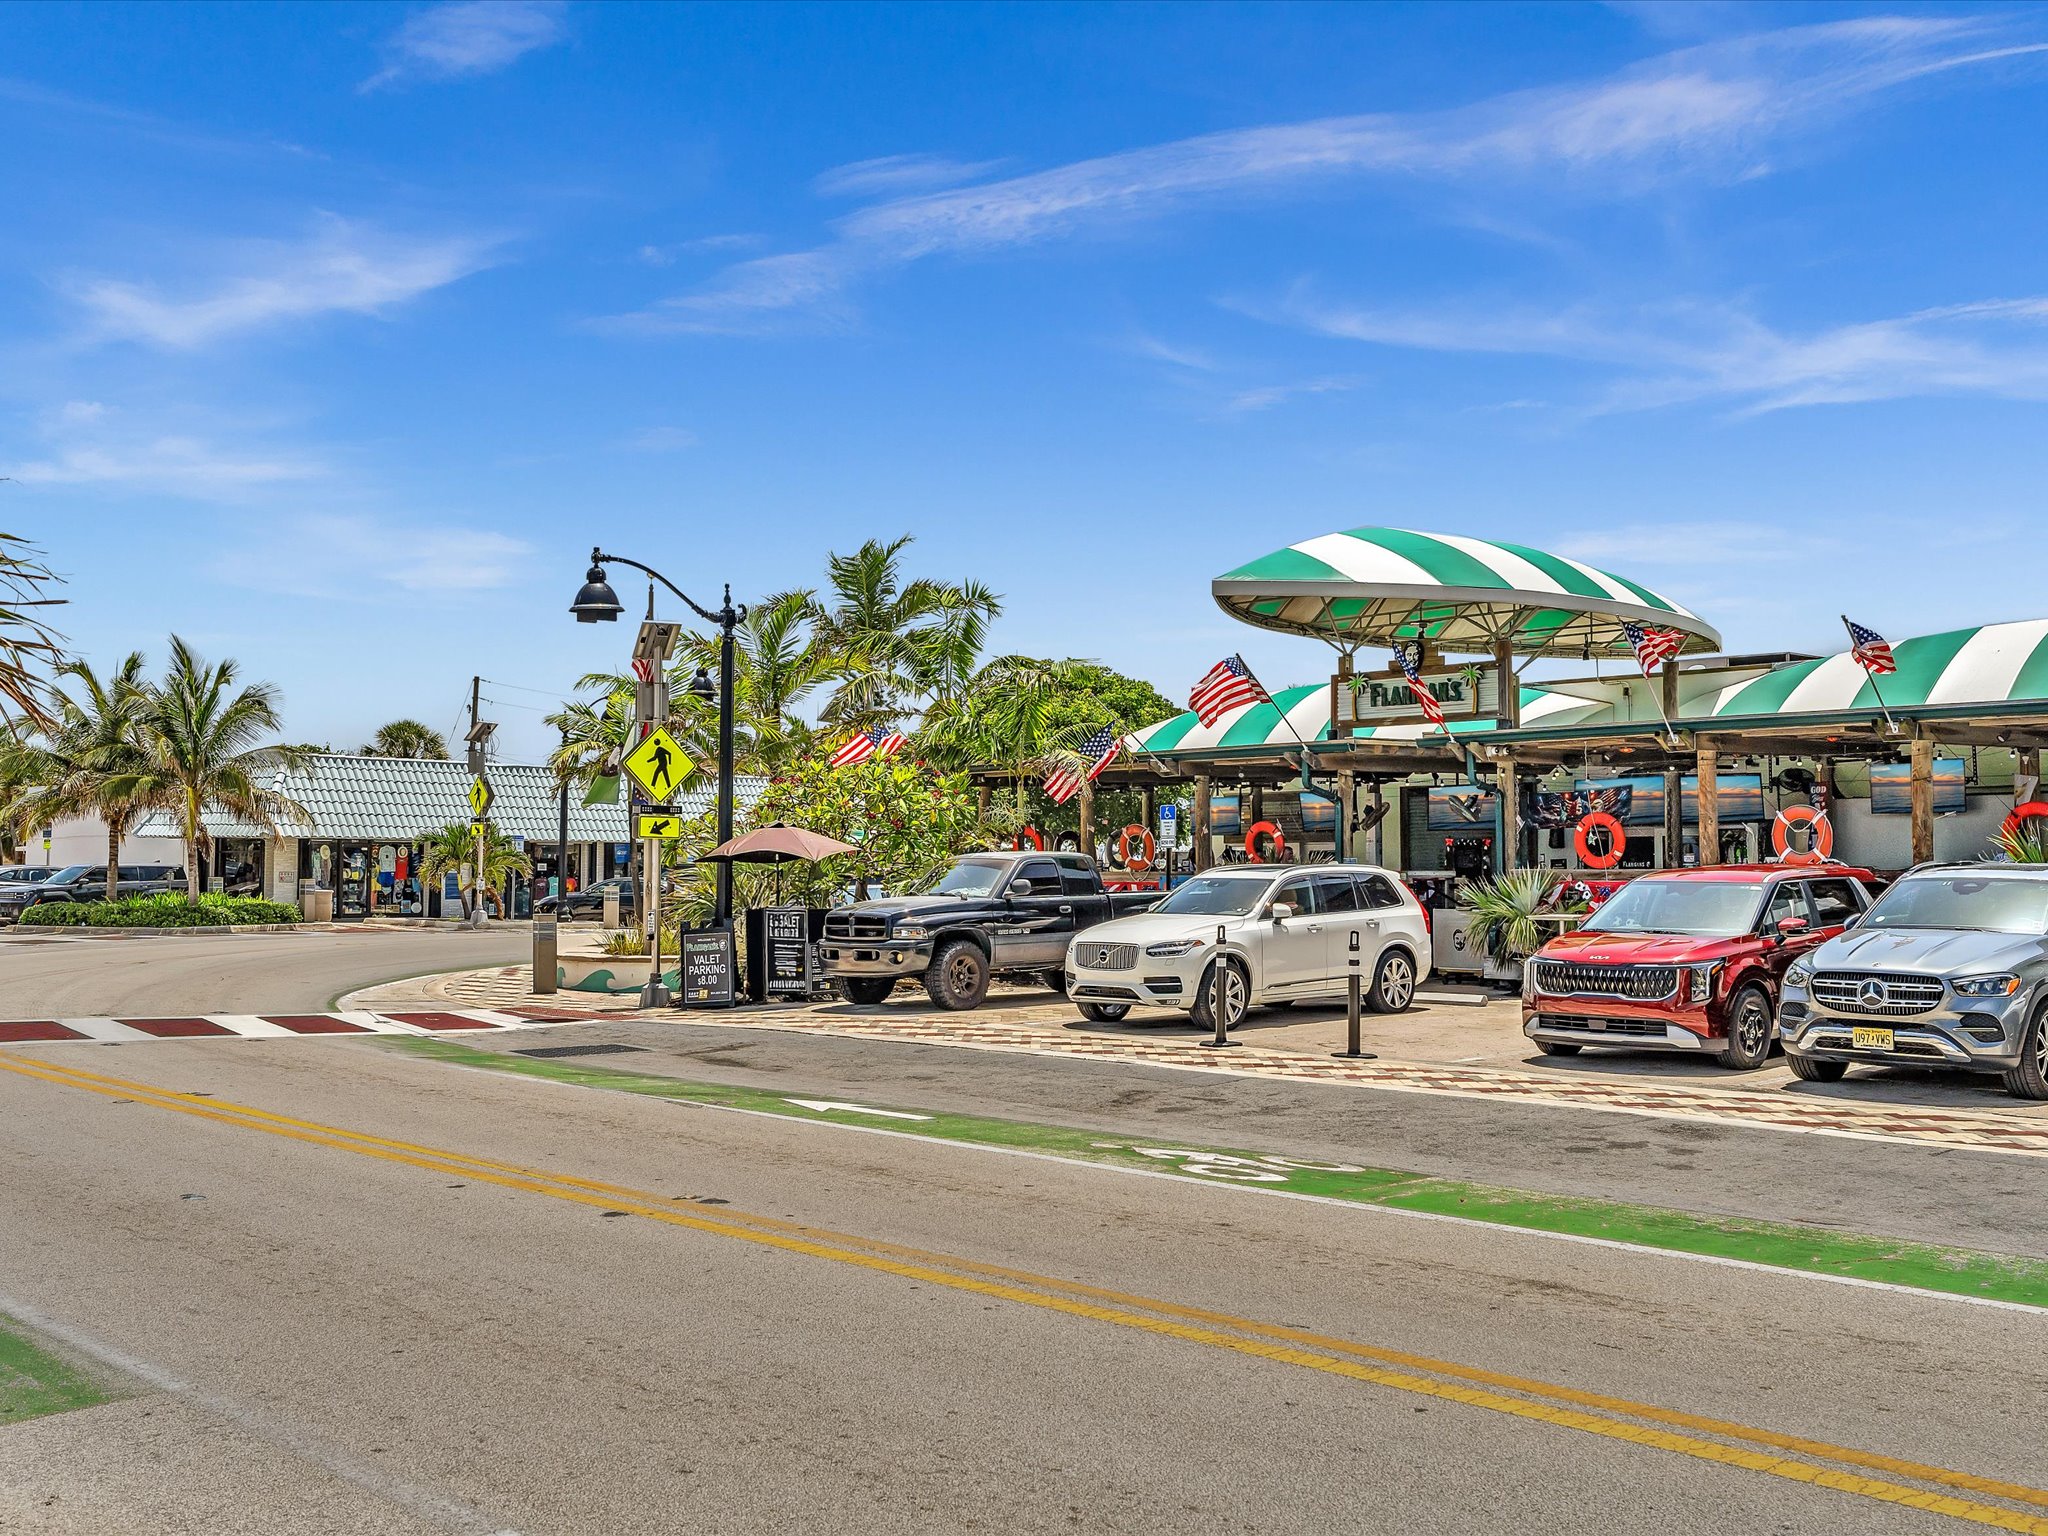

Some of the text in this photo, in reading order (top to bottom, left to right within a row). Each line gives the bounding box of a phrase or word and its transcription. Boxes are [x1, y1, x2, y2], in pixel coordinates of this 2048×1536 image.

[693, 954, 720, 965] VALET
[688, 964, 726, 975] PARKING
[697, 975, 718, 985] $8.00
